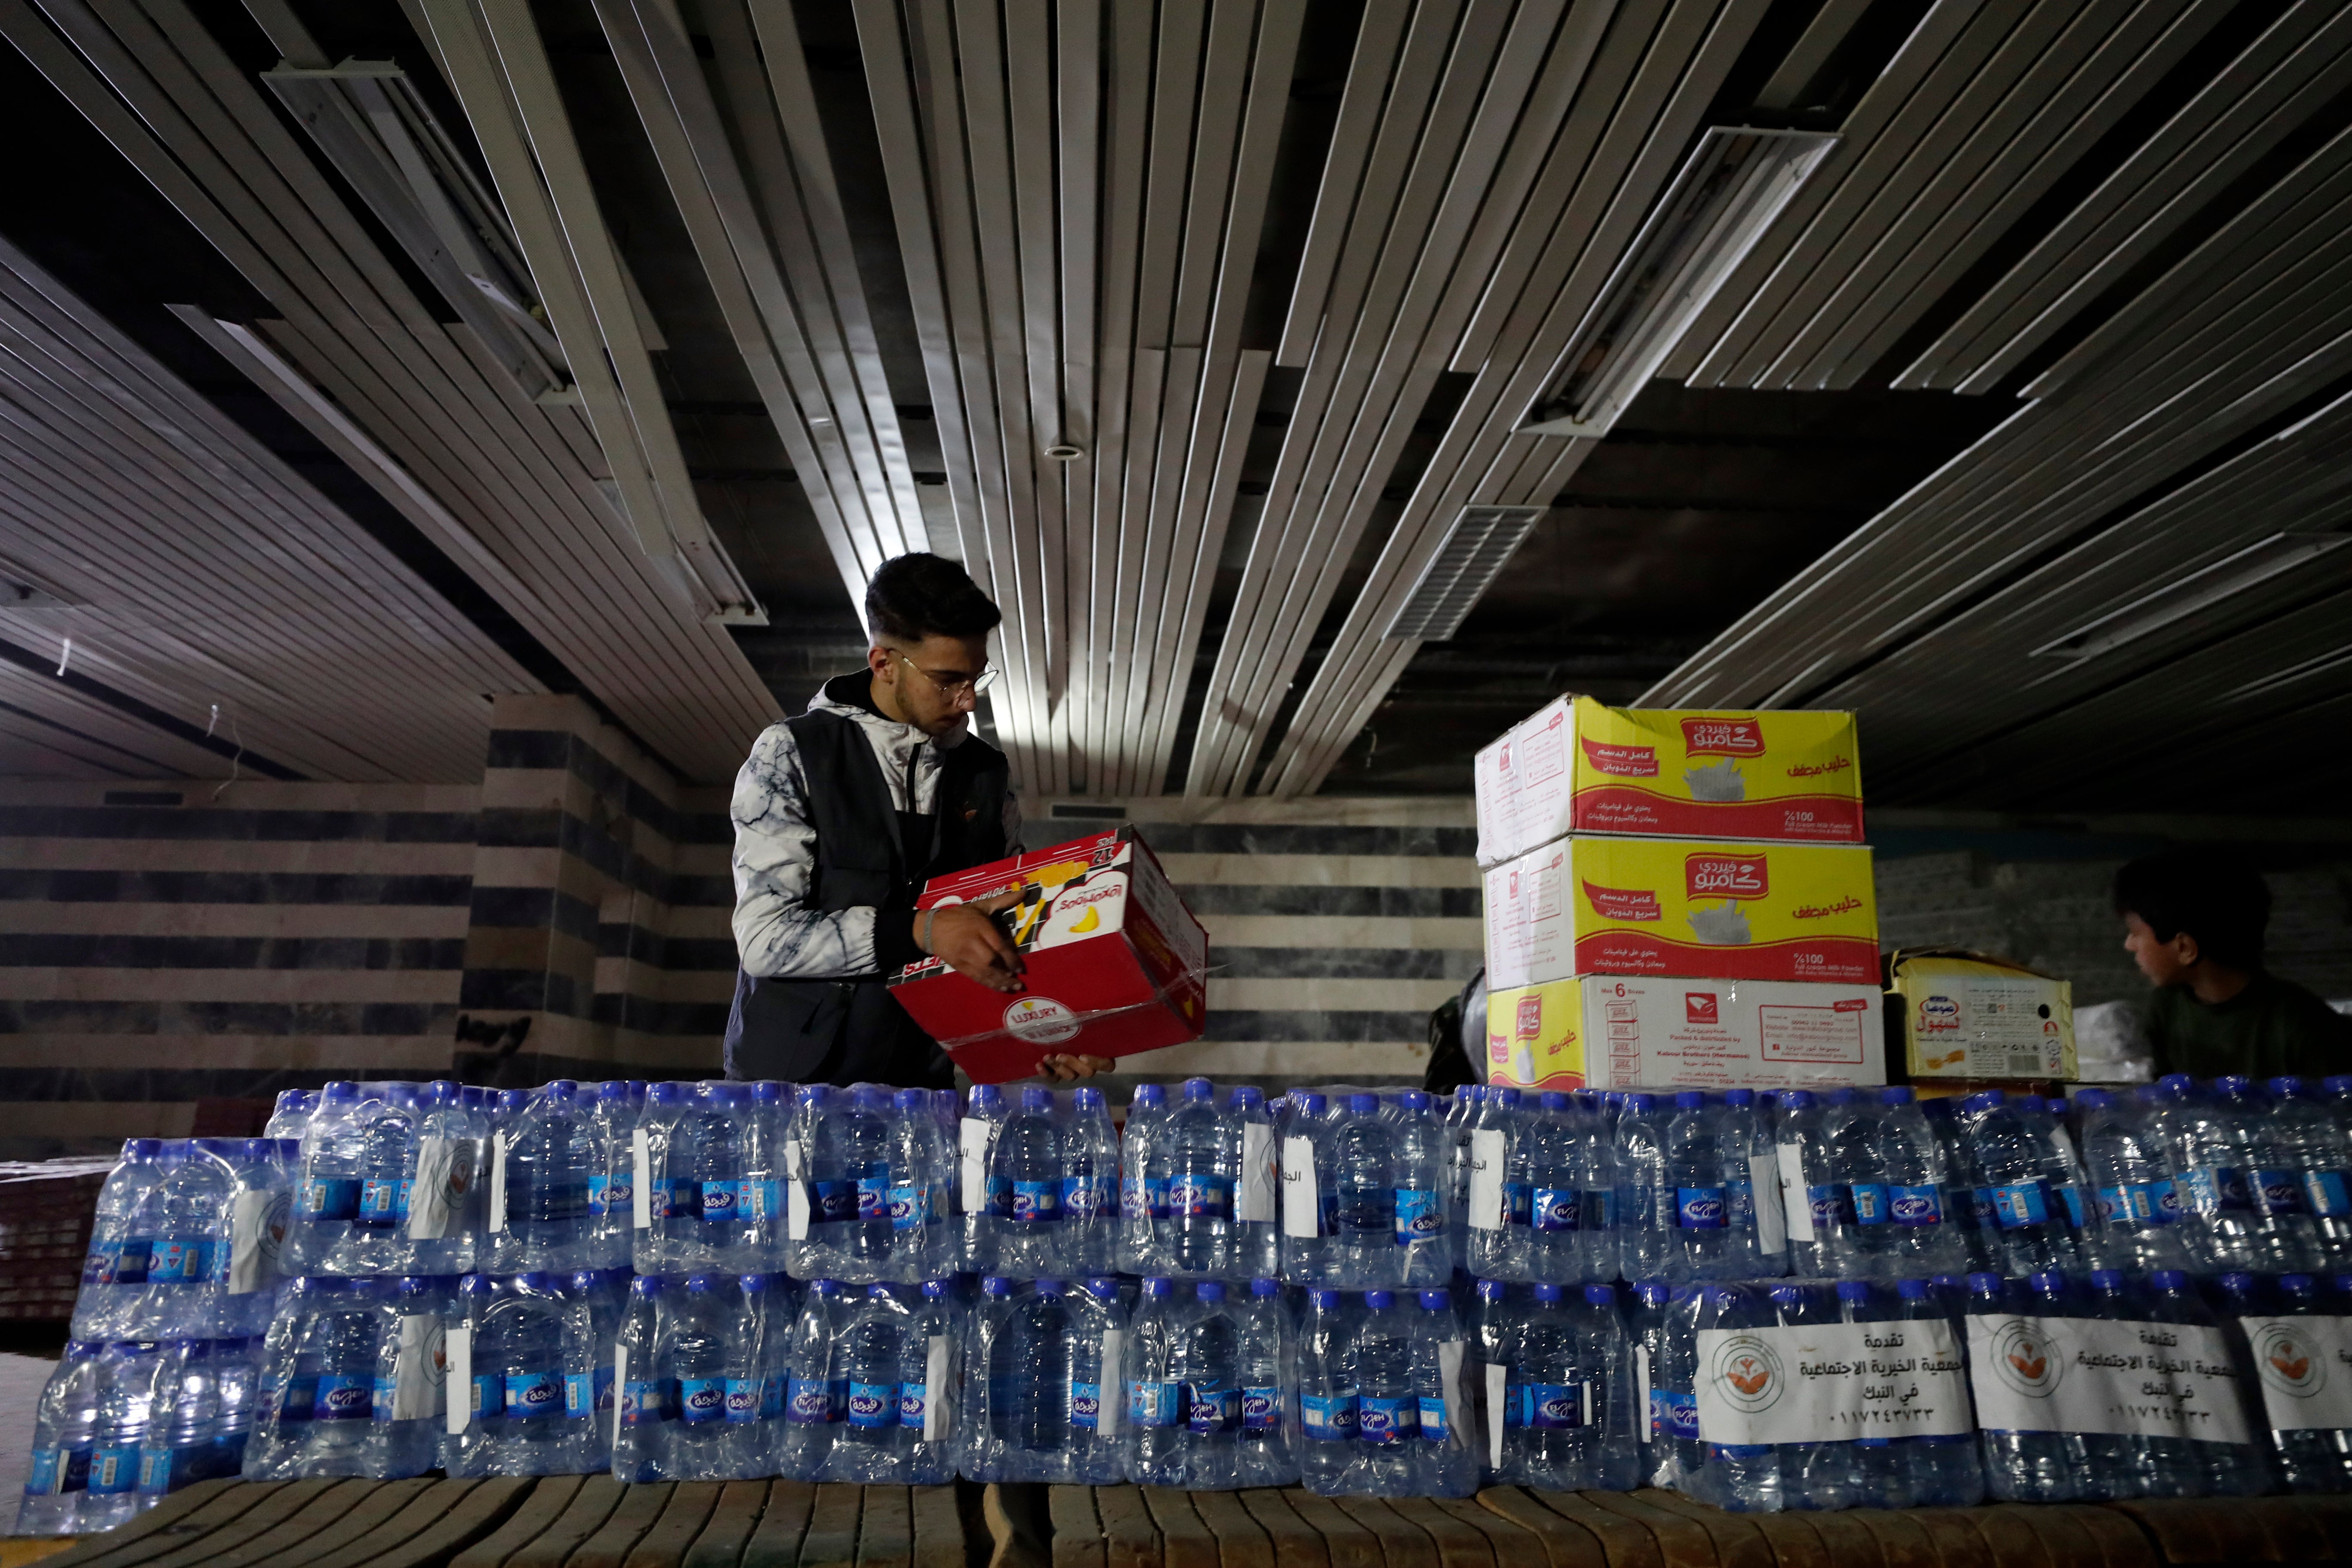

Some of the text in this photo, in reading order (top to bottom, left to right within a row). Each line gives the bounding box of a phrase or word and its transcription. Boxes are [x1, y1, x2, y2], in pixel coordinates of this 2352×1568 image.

[1694, 731, 1757, 748] كامبو
[1629, 751, 1650, 760] كامل
[1603, 763, 1655, 775] سريع الذوبان
[1787, 755, 1851, 778] حليب مجفف
[1093, 846, 1113, 864] 12
[1695, 871, 1761, 891] كامبو
[1600, 894, 1651, 904] كامل الدسم
[1792, 895, 1862, 919] حليب مجفف
[1635, 911, 1657, 919] سريع
[1616, 983, 1625, 997] 6
[1011, 1006, 1057, 1023] LUXURY
[704, 1193, 730, 1208] فيجة
[1418, 1213, 1442, 1231] فيجة
[1864, 1332, 1903, 1348] تقدمة
[2140, 1330, 2177, 1347] تقدمة
[1801, 1360, 1867, 1380] الاجتماعية
[1872, 1359, 1916, 1377] الخيرية
[2078, 1351, 2144, 1372] الاجتماعية
[529, 1384, 557, 1402] فيجة
[694, 1390, 722, 1406] فيجة
[730, 1393, 755, 1409] فيجة
[1863, 1382, 1919, 1406] في النبك
[2175, 1384, 2194, 1407] في
[852, 1398, 878, 1413] فيجة
[1075, 1398, 1098, 1414] فيجة
